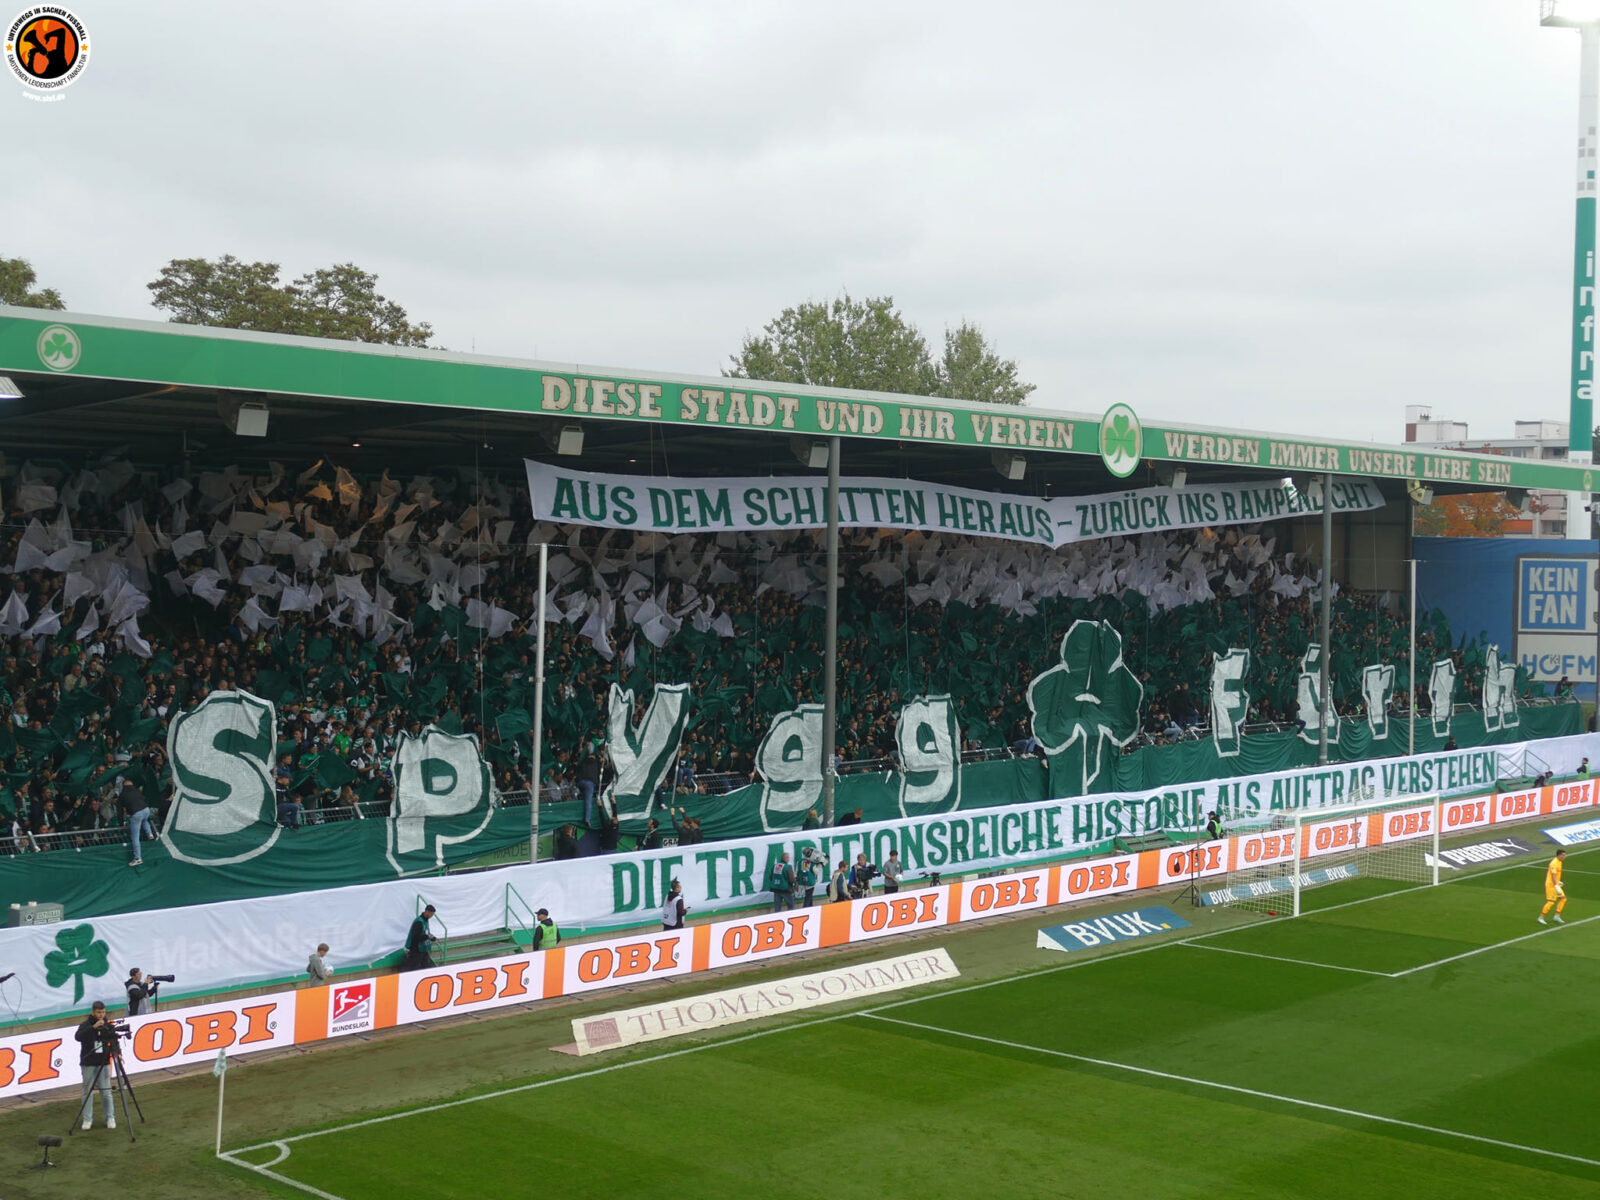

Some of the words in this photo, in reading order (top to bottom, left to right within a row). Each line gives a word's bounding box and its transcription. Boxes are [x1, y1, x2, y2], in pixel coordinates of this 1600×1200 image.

[1576, 250, 1595, 400] infra
[541, 375, 662, 418] DIESE
[681, 387, 799, 428] STADT
[816, 400, 884, 434] UND
[900, 407, 956, 440] IHR
[970, 413, 1074, 450] VEREIN
[1164, 431, 1260, 465] WERDEN
[1269, 442, 1340, 470] IMMER
[1349, 449, 1416, 477] UNSERE
[1424, 456, 1471, 480] LIEBE
[1478, 462, 1512, 484] SEIN
[551, 477, 638, 525] AUS
[646, 487, 735, 528] DEM
[936, 492, 1054, 543] HERAUS
[1076, 492, 1171, 536] ZURÜCK
[1178, 492, 1218, 524] INS
[1529, 567, 1579, 592] KEIN
[1528, 593, 1578, 624] FAN
[1073, 788, 1205, 844] HISTORIE
[1216, 781, 1261, 821] ALS
[1270, 765, 1375, 814] AUFTRAG
[1382, 750, 1496, 797] VERSTEHEN
[1501, 793, 1536, 817] OBI
[1557, 784, 1590, 806] OBI
[1388, 811, 1431, 837] OBI
[1447, 801, 1486, 826] OBI
[1244, 833, 1296, 863] OBI
[1315, 821, 1362, 850] OBI
[1068, 860, 1131, 894] OBI
[1166, 845, 1222, 877] OBI
[970, 876, 1039, 912] OBI
[861, 893, 939, 932] OBI
[1063, 911, 1172, 947] BVUK.
[722, 915, 810, 958] OBI
[578, 937, 680, 983] OBI
[414, 961, 530, 1012] OBI
[627, 985, 795, 1036] THOMAS
[802, 955, 949, 1000] SOMMER
[357, 1001, 369, 1017] 2
[133, 1003, 277, 1062] OBI
[332, 1021, 370, 1033] BUNDESLIGA
